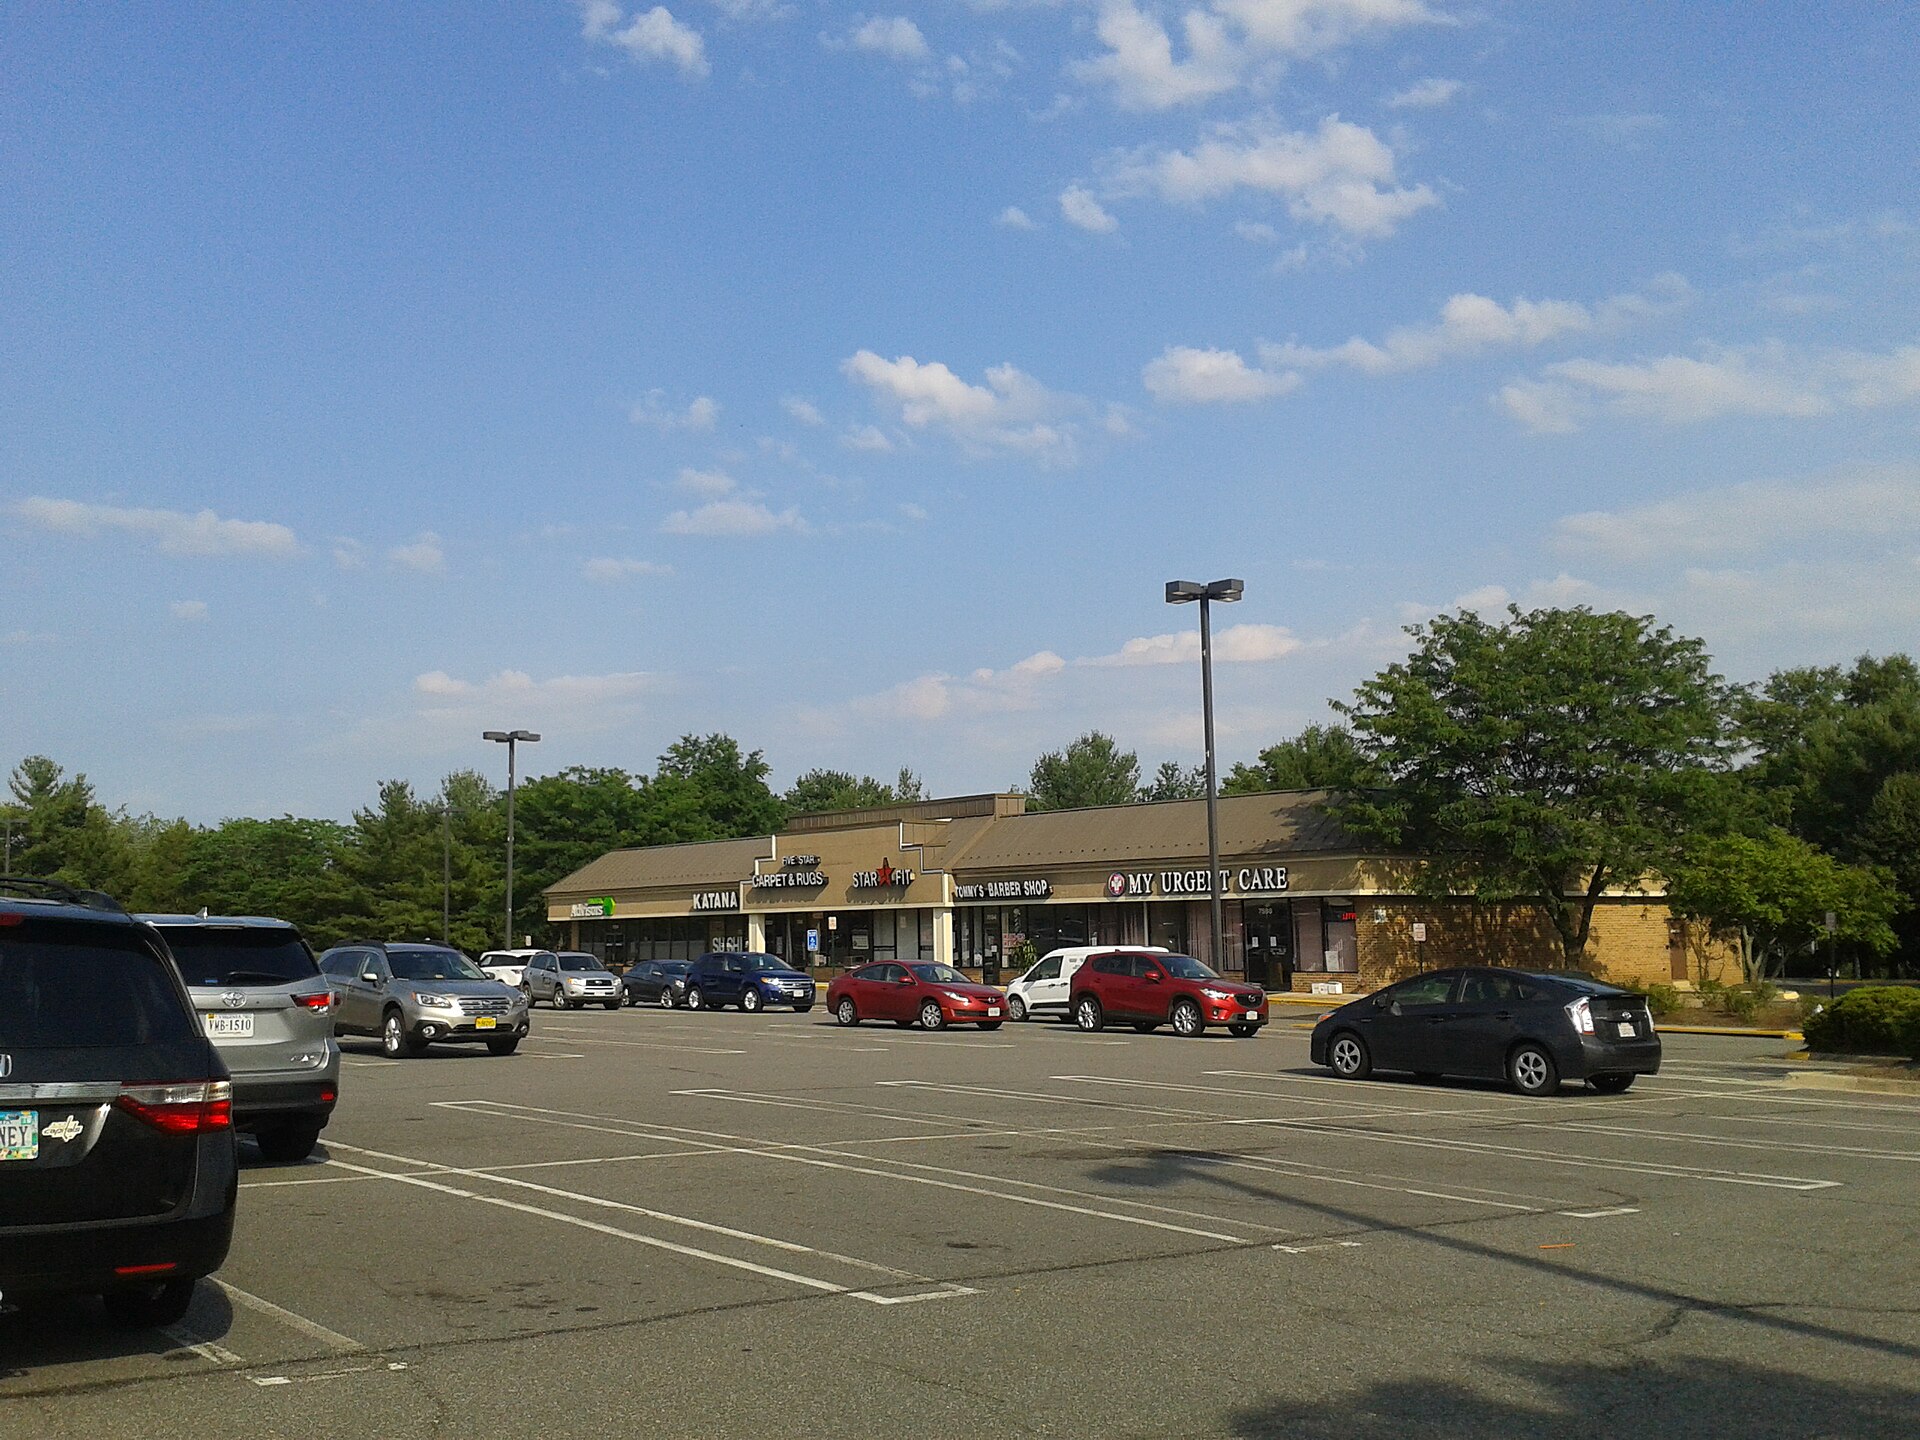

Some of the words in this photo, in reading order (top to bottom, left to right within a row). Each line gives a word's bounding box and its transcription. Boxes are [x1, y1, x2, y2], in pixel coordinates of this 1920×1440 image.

[798, 855, 815, 865] STAR
[752, 873, 788, 888] CARPET
[788, 873, 796, 886] &
[796, 872, 824, 886] RUGS
[852, 871, 878, 888] STAR
[895, 869, 911, 886] FIT
[1128, 873, 1153, 894] MY
[1238, 868, 1288, 890] CARE
[987, 881, 1022, 897] BARBER
[1023, 879, 1048, 896] SHOP
[693, 891, 738, 910] KATANA
[712, 937, 743, 953] SUSHI
